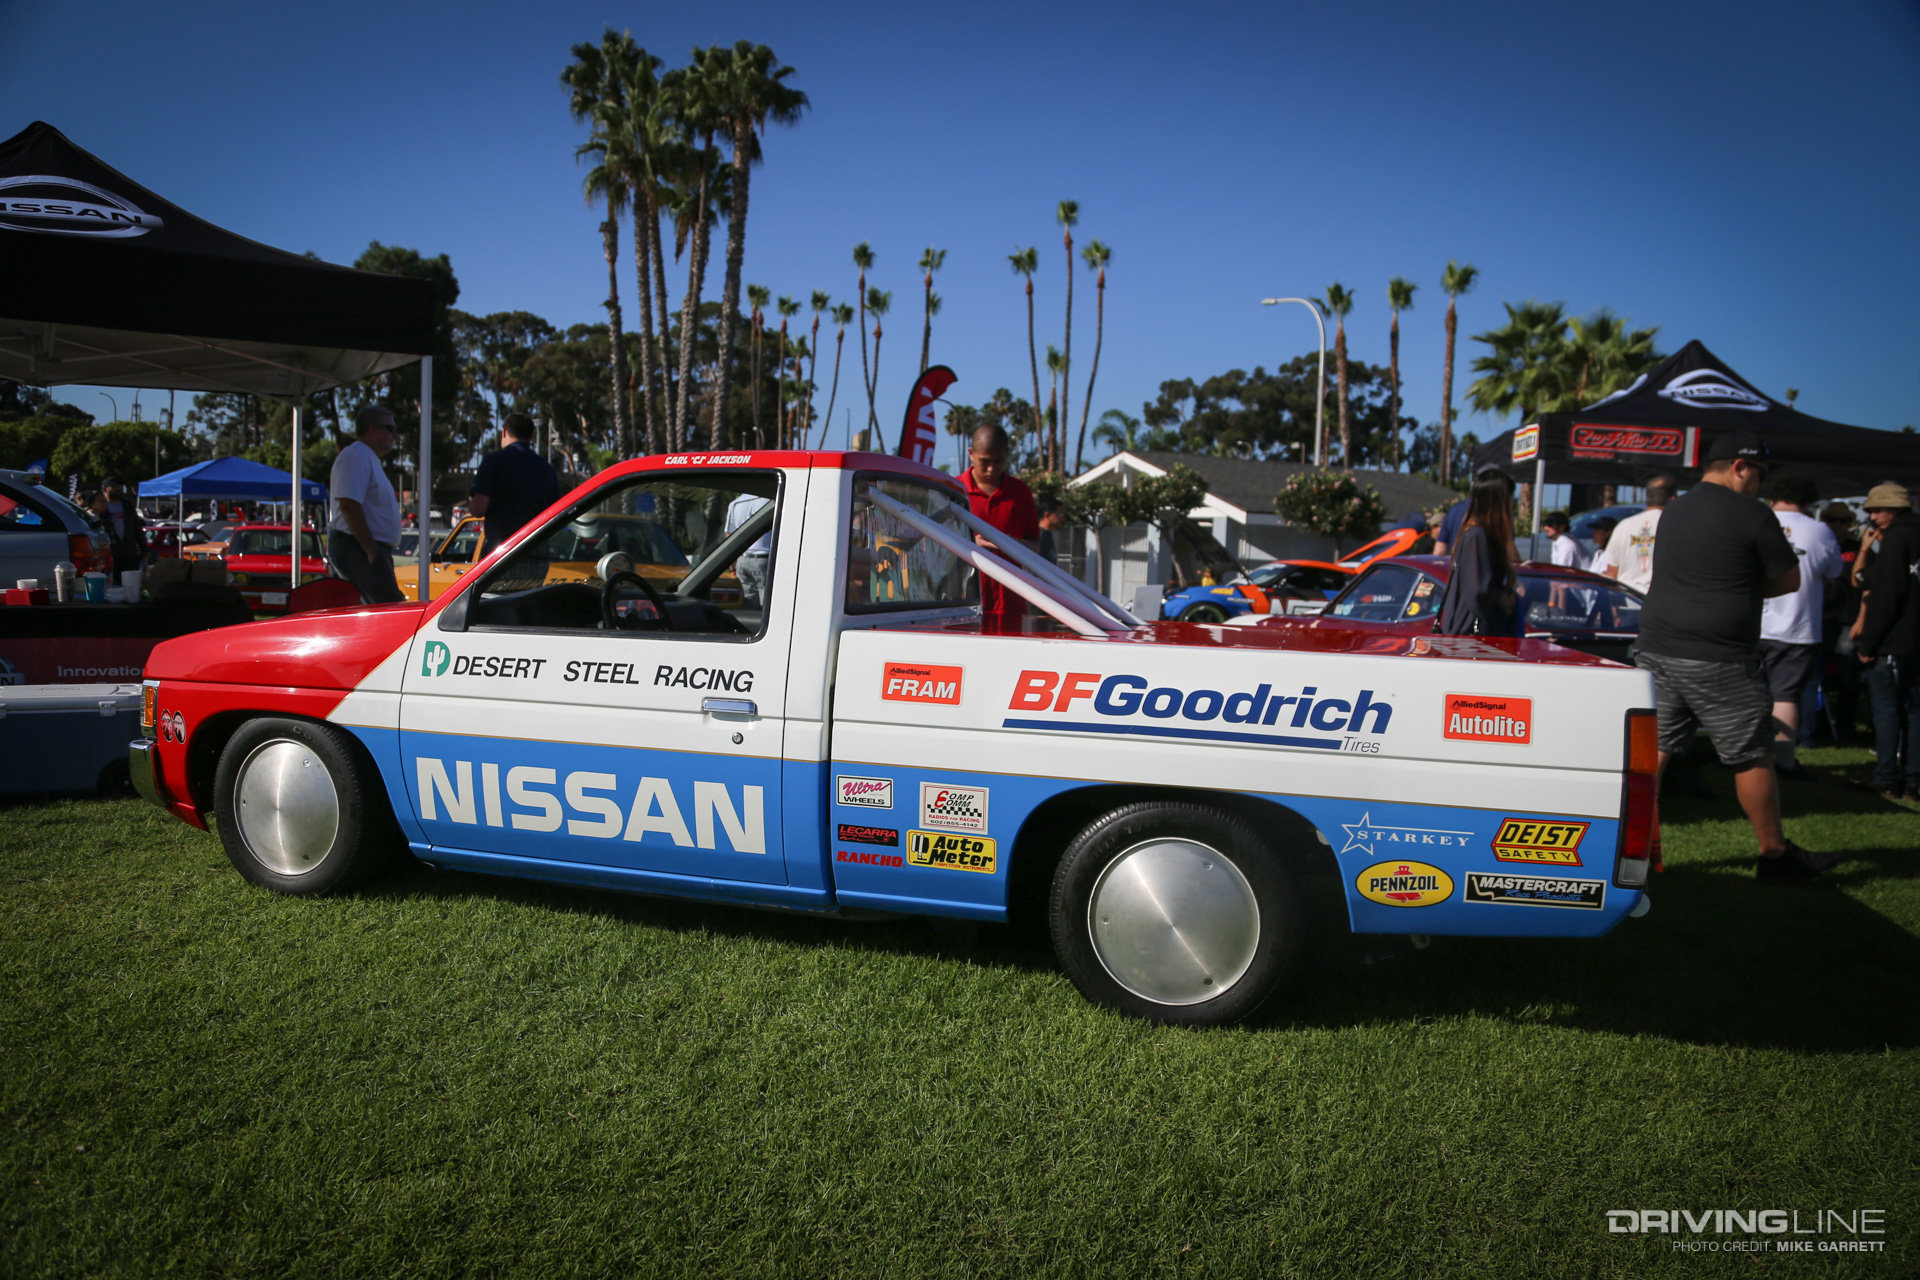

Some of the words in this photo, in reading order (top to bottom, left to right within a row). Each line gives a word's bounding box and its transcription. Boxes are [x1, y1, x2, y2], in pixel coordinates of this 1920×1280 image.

[664, 455, 689, 465] CARL
[707, 454, 752, 465] JACKSON
[57, 665, 144, 678] Innovatio
[452, 655, 547, 680] DESERT
[563, 660, 640, 686] STEEL
[653, 664, 755, 693] RACING
[890, 667, 931, 677] AlliedSignal
[886, 678, 957, 700] FRAM
[1008, 669, 1394, 735] BFGoodrich
[1453, 700, 1507, 710] AlliedSignal
[1448, 713, 1527, 738] Autolite
[1342, 735, 1381, 754] Tires
[842, 781, 893, 796] Ultra
[416, 757, 767, 855] NISSAN
[843, 796, 885, 805] WHEELS
[839, 826, 897, 838] LECARRA
[1356, 829, 1471, 847] STARKEY
[1500, 823, 1581, 846] DEIST
[933, 836, 984, 853] Auto
[836, 851, 903, 868] RANCHO
[929, 849, 993, 867] Meter
[1499, 849, 1572, 861] SAFETY
[1369, 874, 1440, 893] PENNZOIL
[1479, 876, 1601, 895] MASTERCRAFT
[1505, 889, 1531, 898] Race
[1534, 891, 1584, 901] Products
